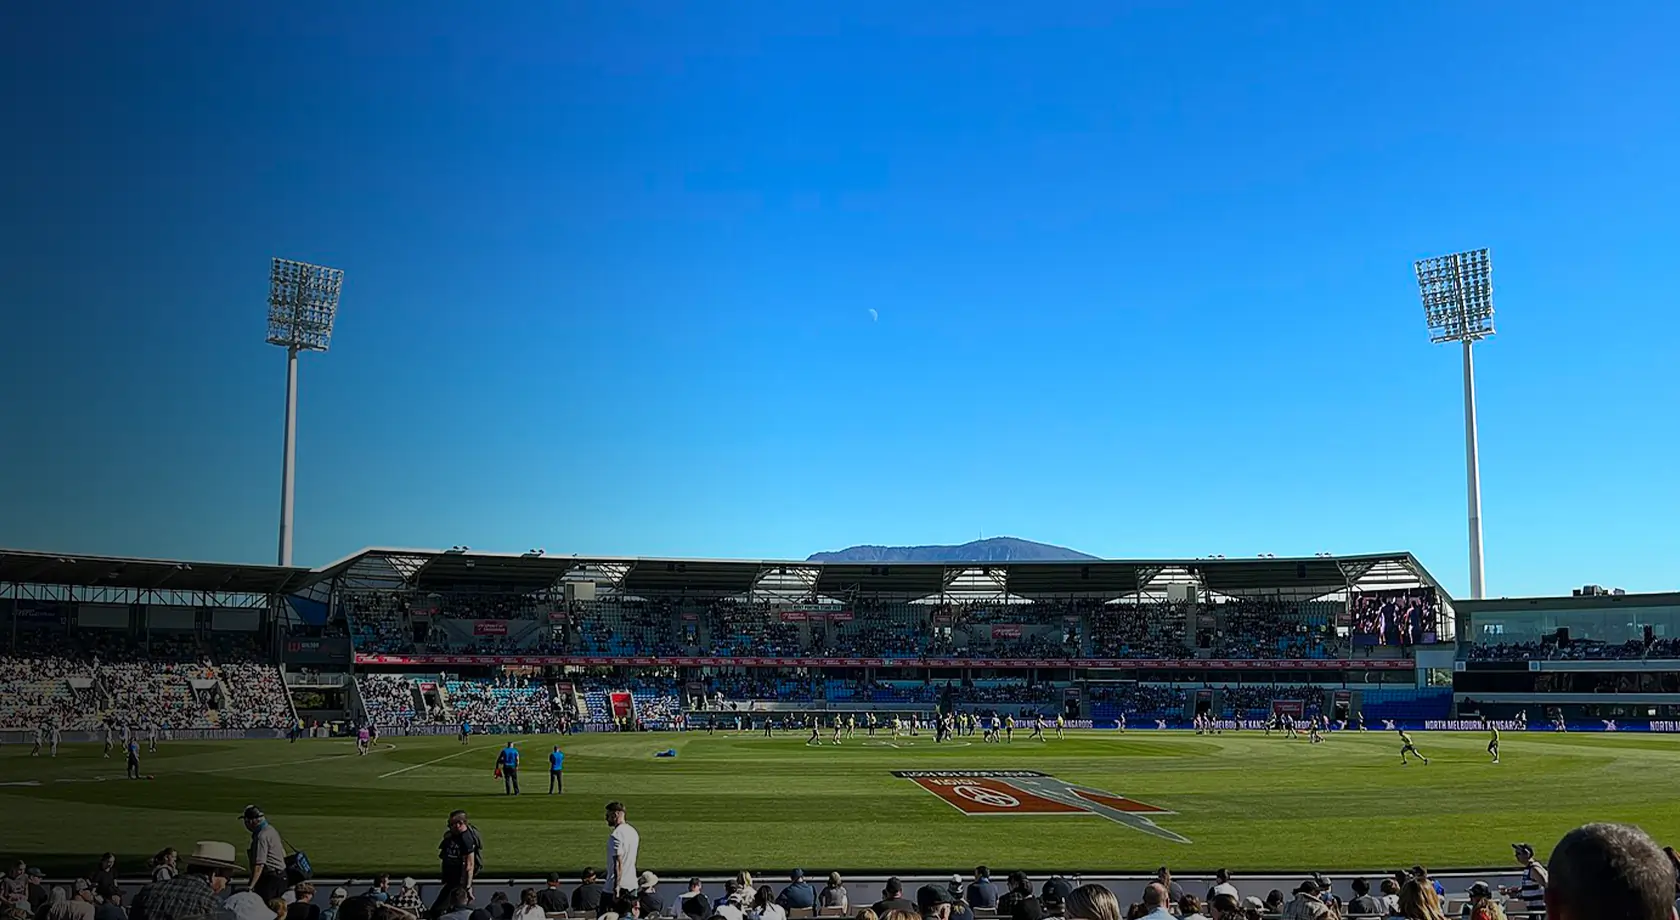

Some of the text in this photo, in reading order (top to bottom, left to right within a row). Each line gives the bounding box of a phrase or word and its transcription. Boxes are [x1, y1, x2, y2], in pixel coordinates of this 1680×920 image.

[1060, 720, 1094, 728] ANGAROOS
[1425, 720, 1447, 730] NORTH
[1649, 720, 1674, 732] NORTH
